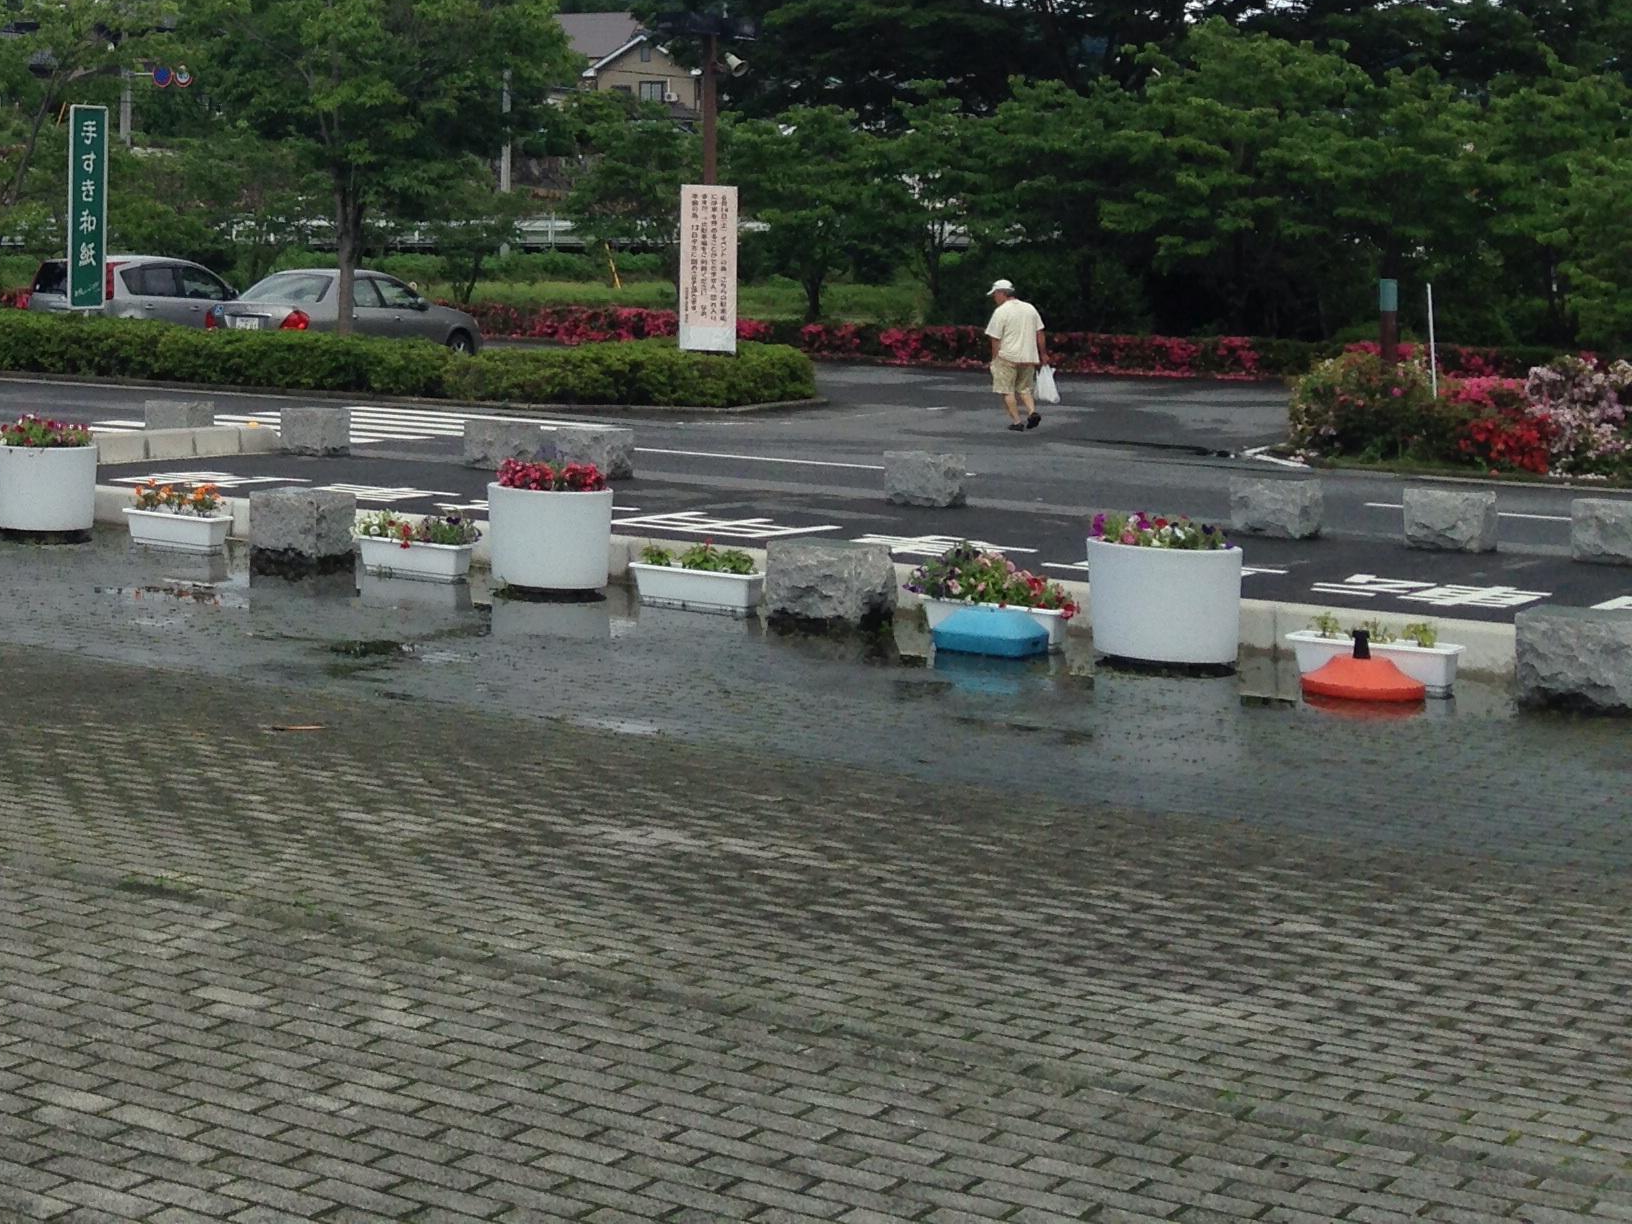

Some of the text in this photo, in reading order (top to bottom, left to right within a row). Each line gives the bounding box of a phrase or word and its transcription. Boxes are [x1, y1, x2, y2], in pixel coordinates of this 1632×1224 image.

[78, 120, 97, 266] 手すき和紙
